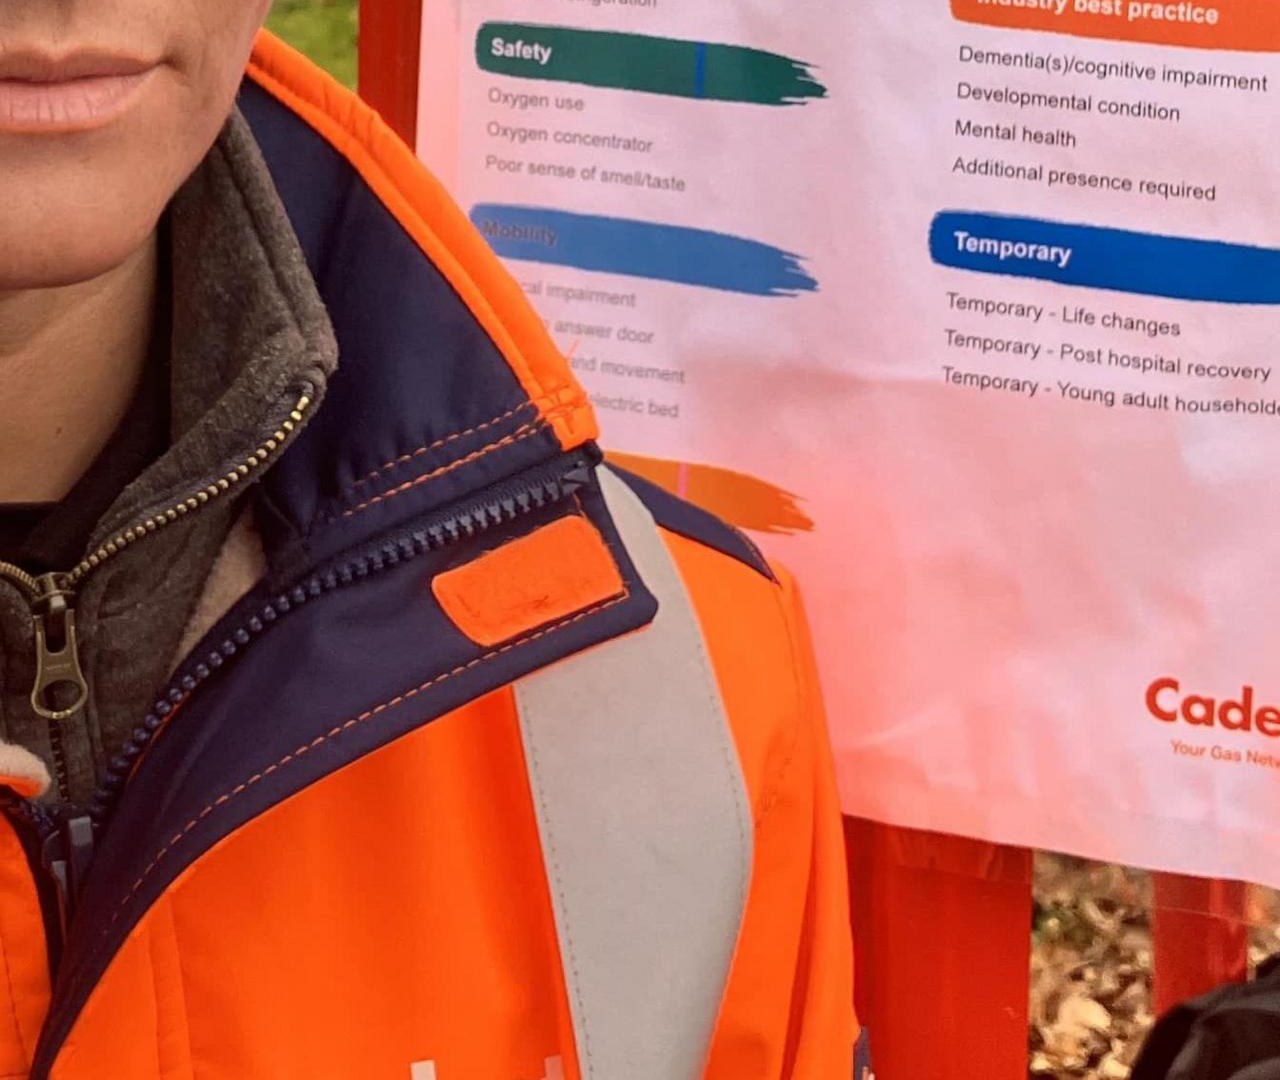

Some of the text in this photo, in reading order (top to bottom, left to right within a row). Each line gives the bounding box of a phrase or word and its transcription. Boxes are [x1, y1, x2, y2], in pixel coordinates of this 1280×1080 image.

[1128, 0, 1219, 25] practice
[490, 37, 552, 65] Safety
[959, 45, 1268, 92] Dementia(s)/cognitive impairment
[487, 88, 585, 113] Oxygen use
[957, 82, 1180, 122] Developmental condition
[486, 122, 653, 153] Oxygen concentrator
[955, 120, 1076, 148] Mental health
[485, 156, 686, 193] Poor sense of smell/taste
[952, 157, 1216, 201] Additional presence required
[483, 221, 558, 247] Mobility
[955, 232, 1072, 267] Temporary
[547, 283, 637, 307] impairment
[946, 292, 1181, 337] Temporary Life changes
[554, 320, 655, 344] answer door
[944, 329, 1272, 383] Temporary Post hospital recovery
[601, 359, 685, 384] movement
[943, 366, 1039, 397] Temporary
[1057, 383, 1116, 408] Young
[1122, 391, 1169, 412] adult
[648, 399, 679, 418] bed
[1170, 740, 1205, 757] Your
[1211, 745, 1241, 763] Gas
